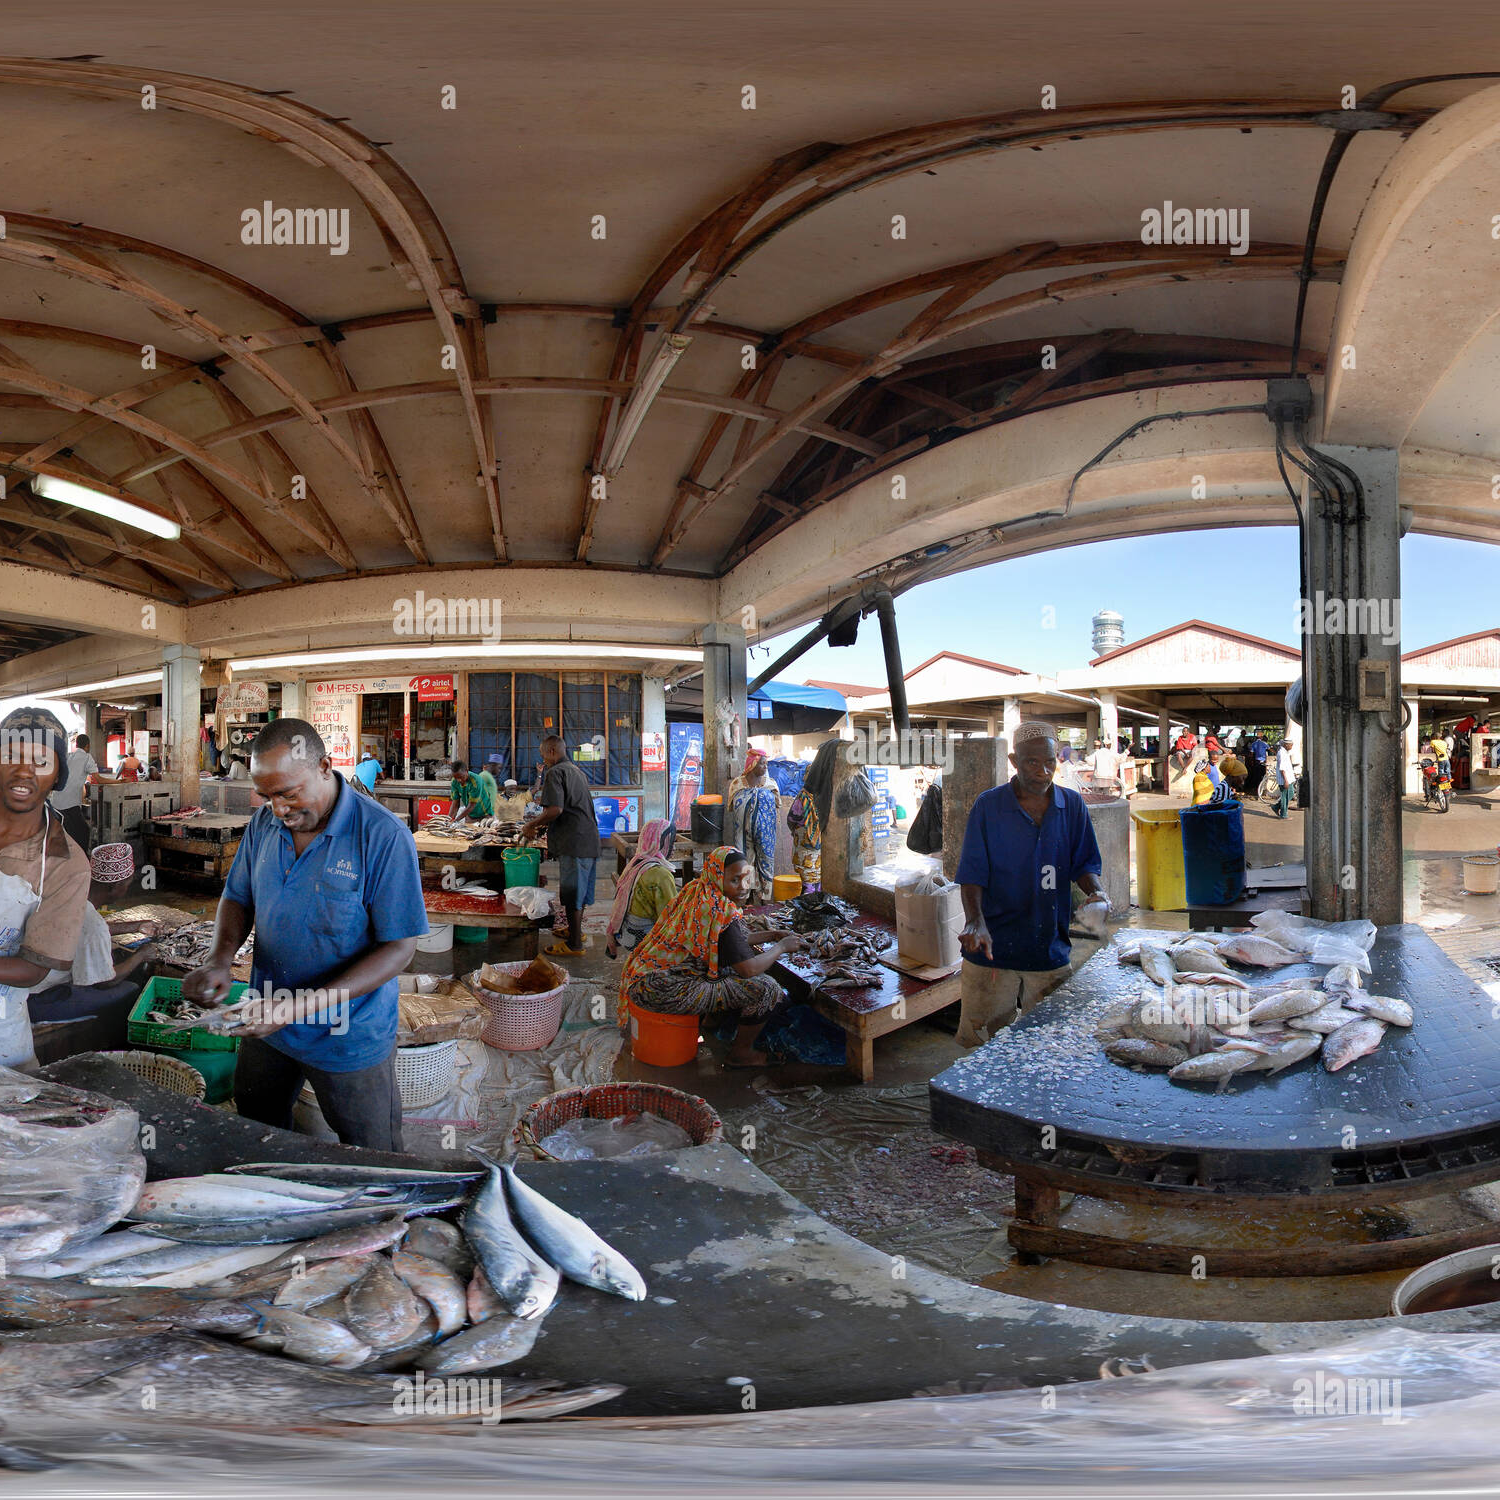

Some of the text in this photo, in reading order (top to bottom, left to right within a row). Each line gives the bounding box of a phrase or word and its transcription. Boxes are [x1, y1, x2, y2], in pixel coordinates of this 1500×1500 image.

[432, 679, 450, 687] airtel
[326, 683, 366, 694] M-PESA
[313, 711, 340, 723] LUKU
[314, 723, 349, 732] StarTimes
[643, 747, 656, 756] ON
